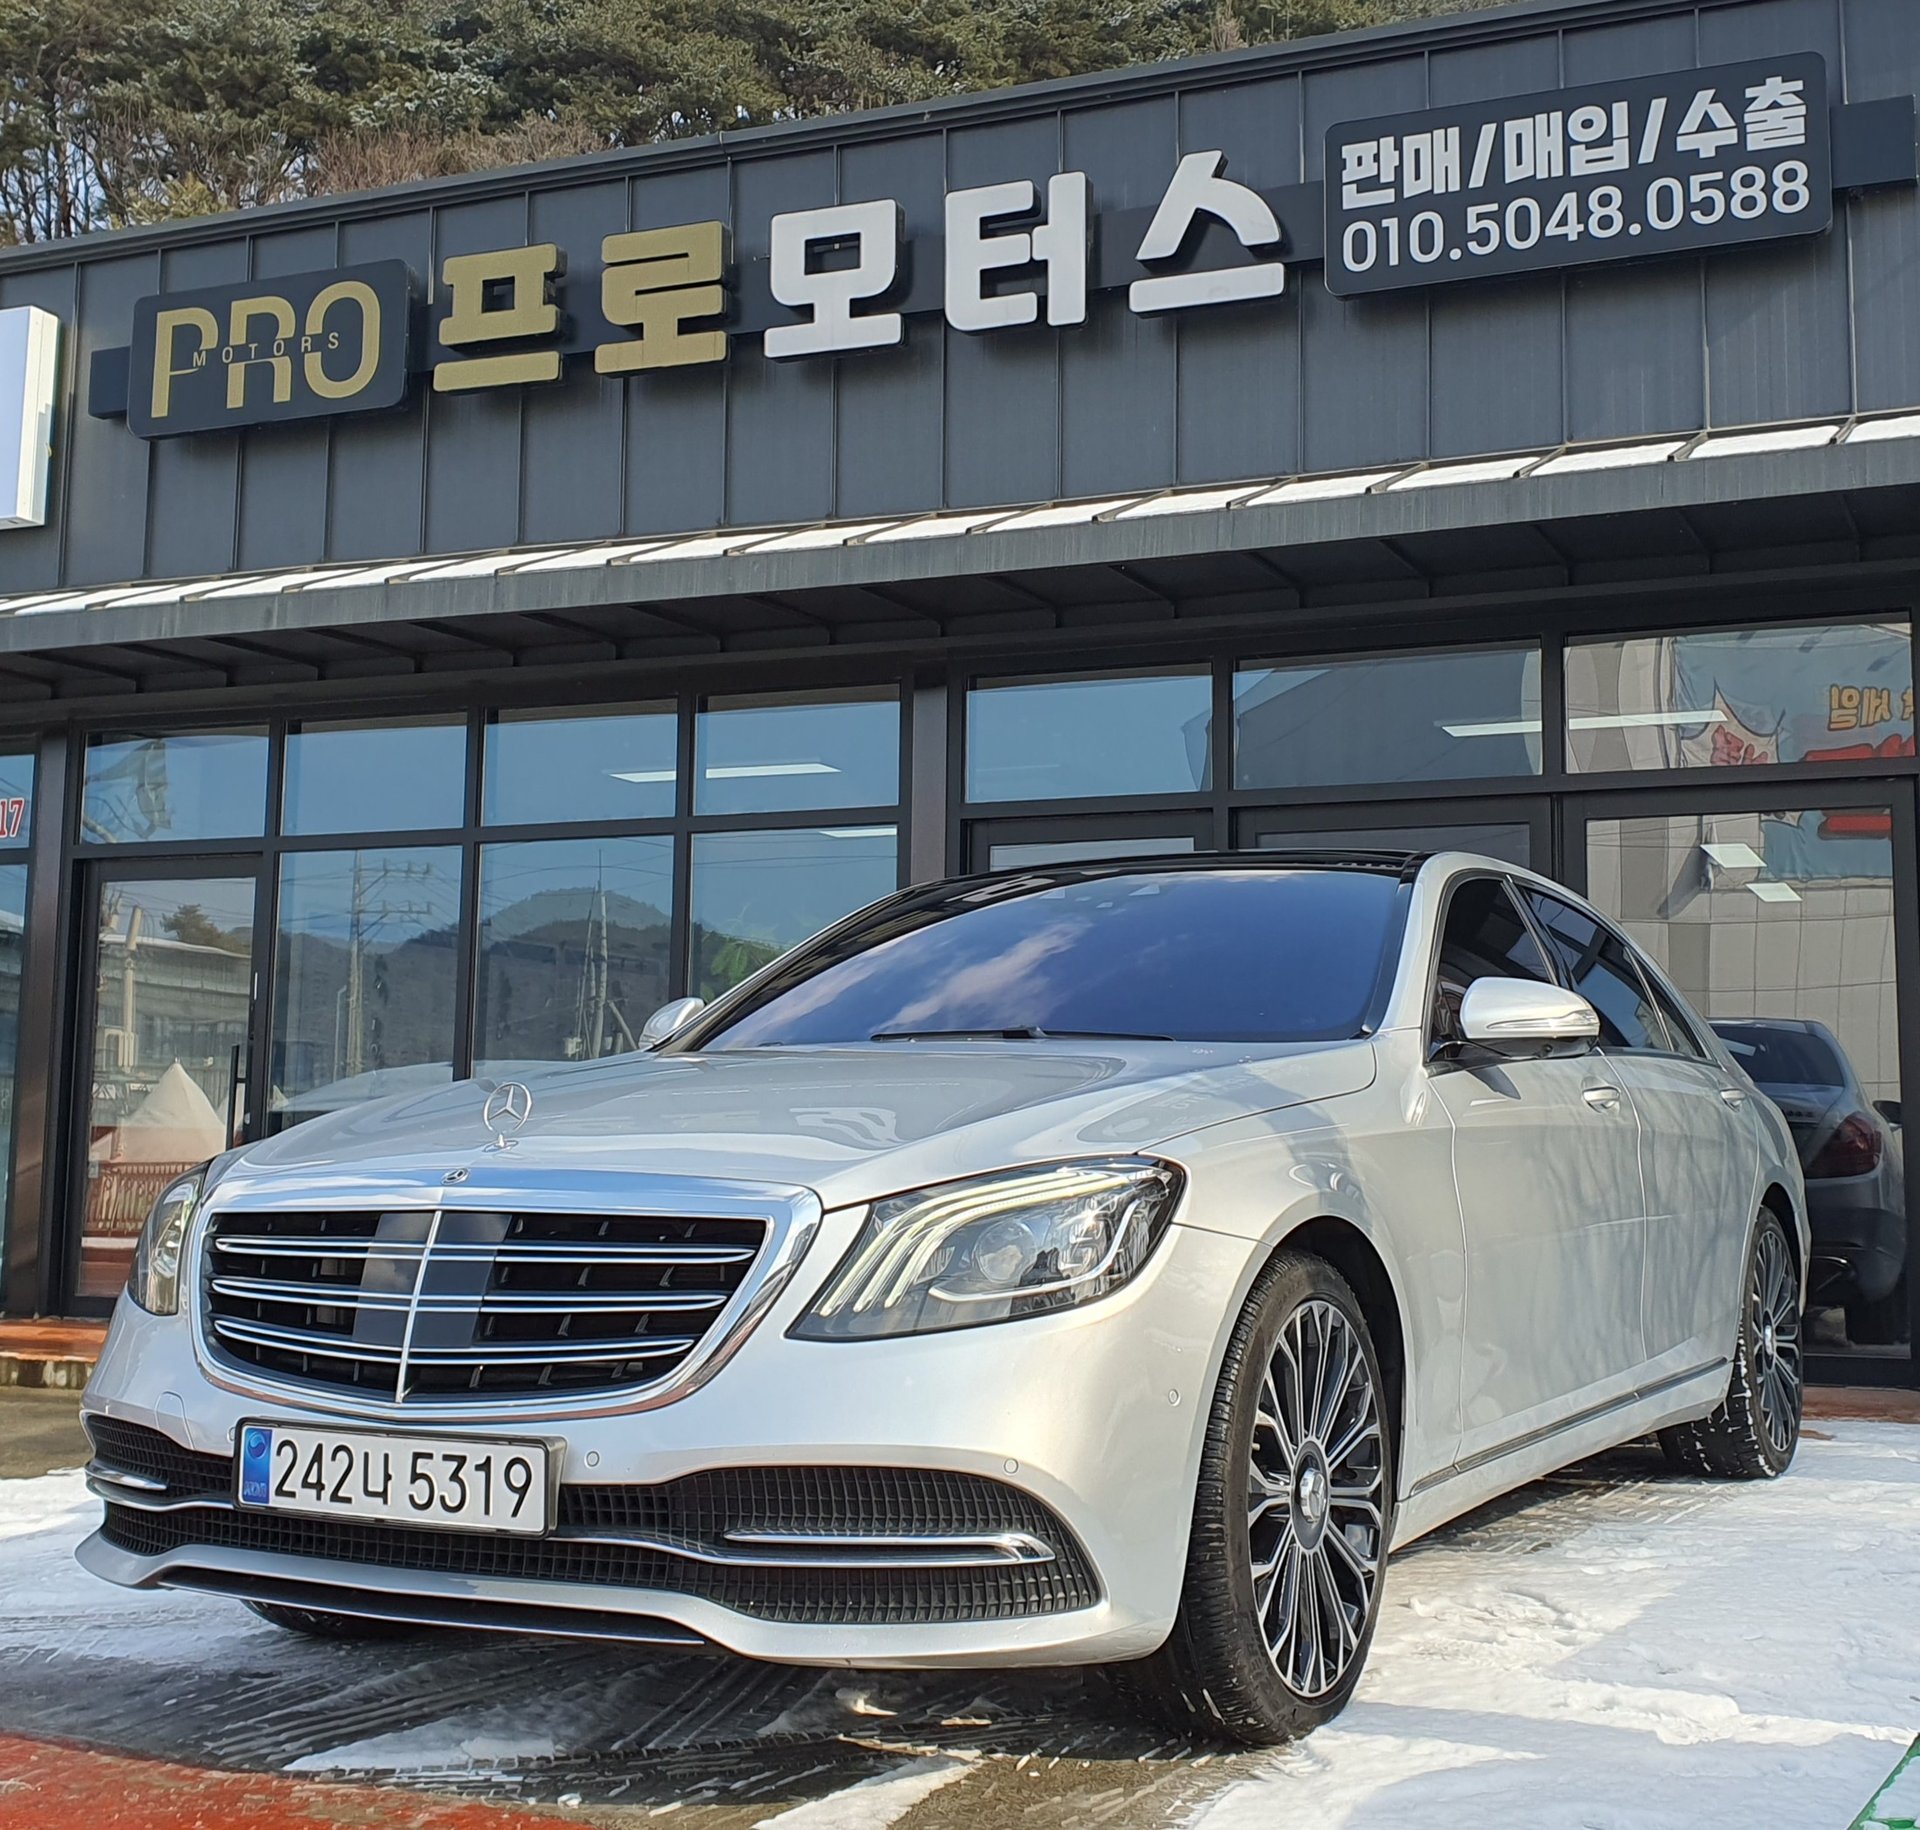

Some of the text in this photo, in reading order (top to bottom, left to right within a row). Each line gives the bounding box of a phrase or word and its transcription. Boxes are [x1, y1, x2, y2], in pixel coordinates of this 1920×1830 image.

[1341, 75, 1807, 209] 판매/매입/수출
[1341, 160, 1811, 273] 010.5048.0588
[151, 280, 381, 418] PRO
[192, 332, 340, 367] MOTORS
[274, 1439, 533, 1518] 242나 5319
